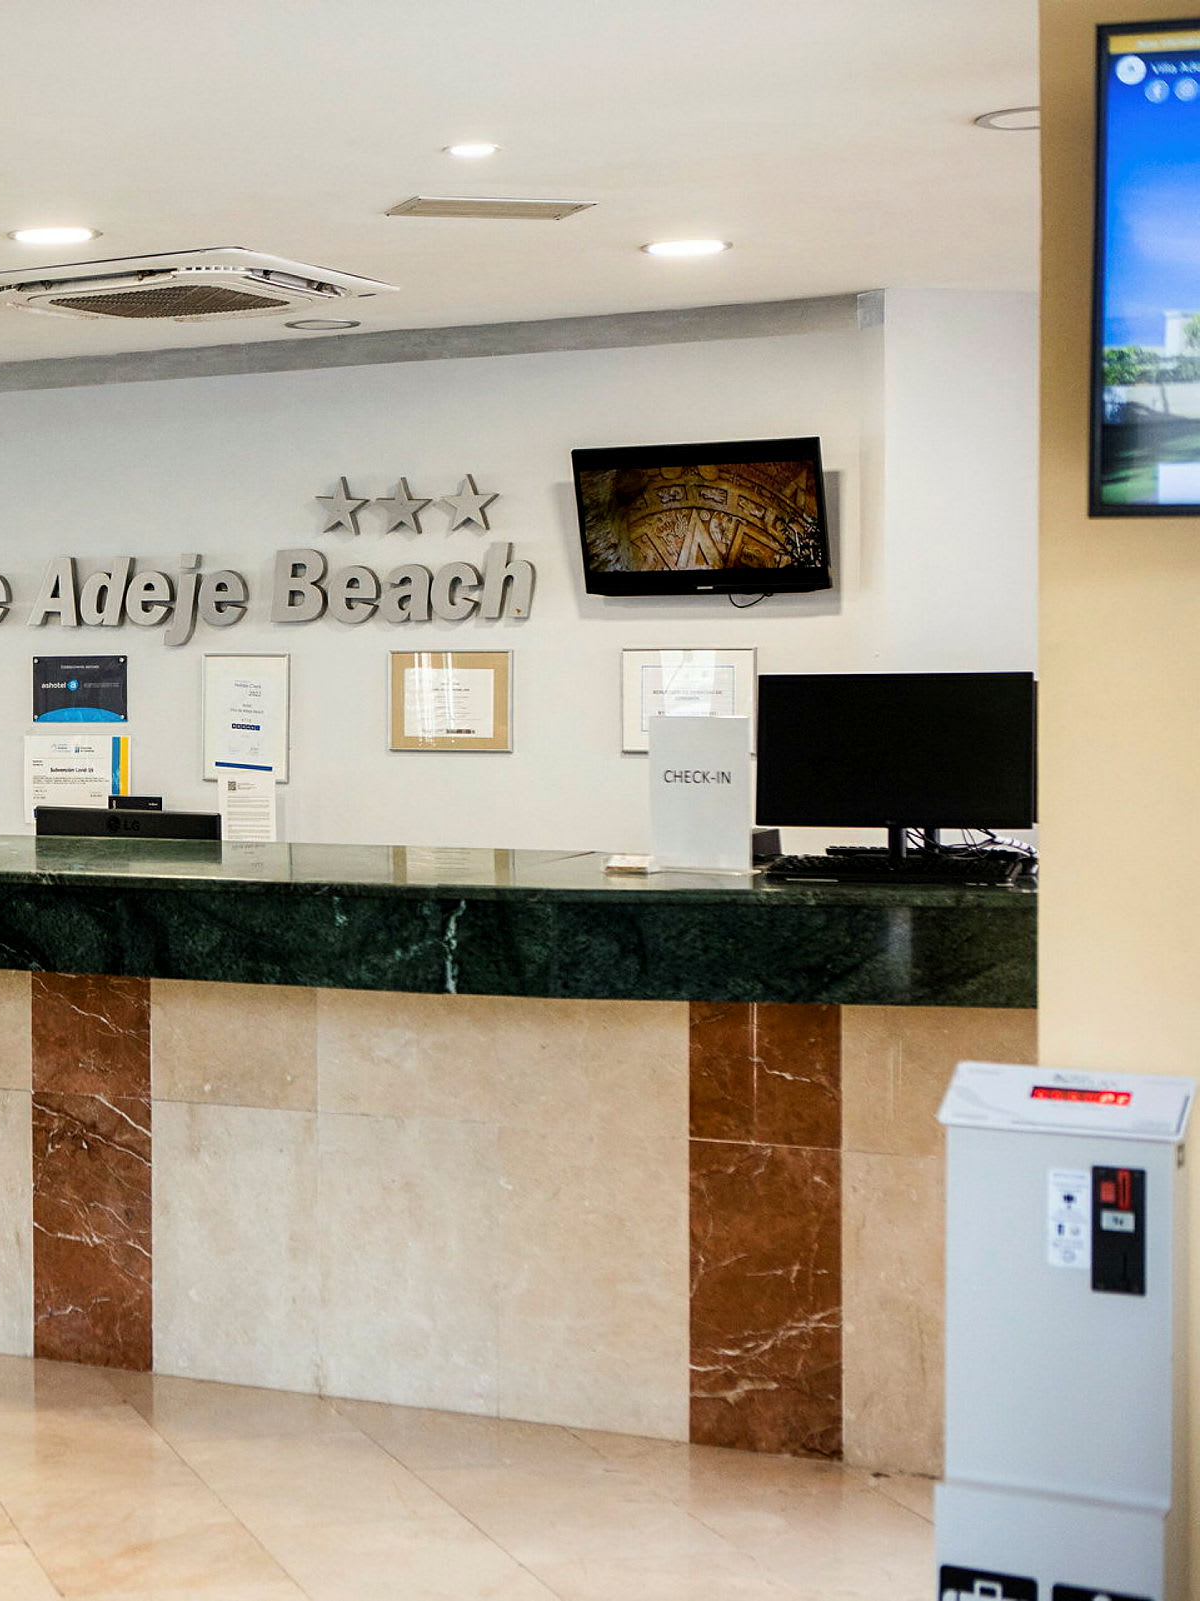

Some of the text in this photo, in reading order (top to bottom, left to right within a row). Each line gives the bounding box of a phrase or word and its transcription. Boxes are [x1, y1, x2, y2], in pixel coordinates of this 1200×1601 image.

[27, 552, 250, 646] Adeje
[271, 542, 537, 625] Beach
[41, 681, 66, 689] ashotel
[663, 769, 732, 785] CHECK-IN
[123, 817, 140, 832] LG
